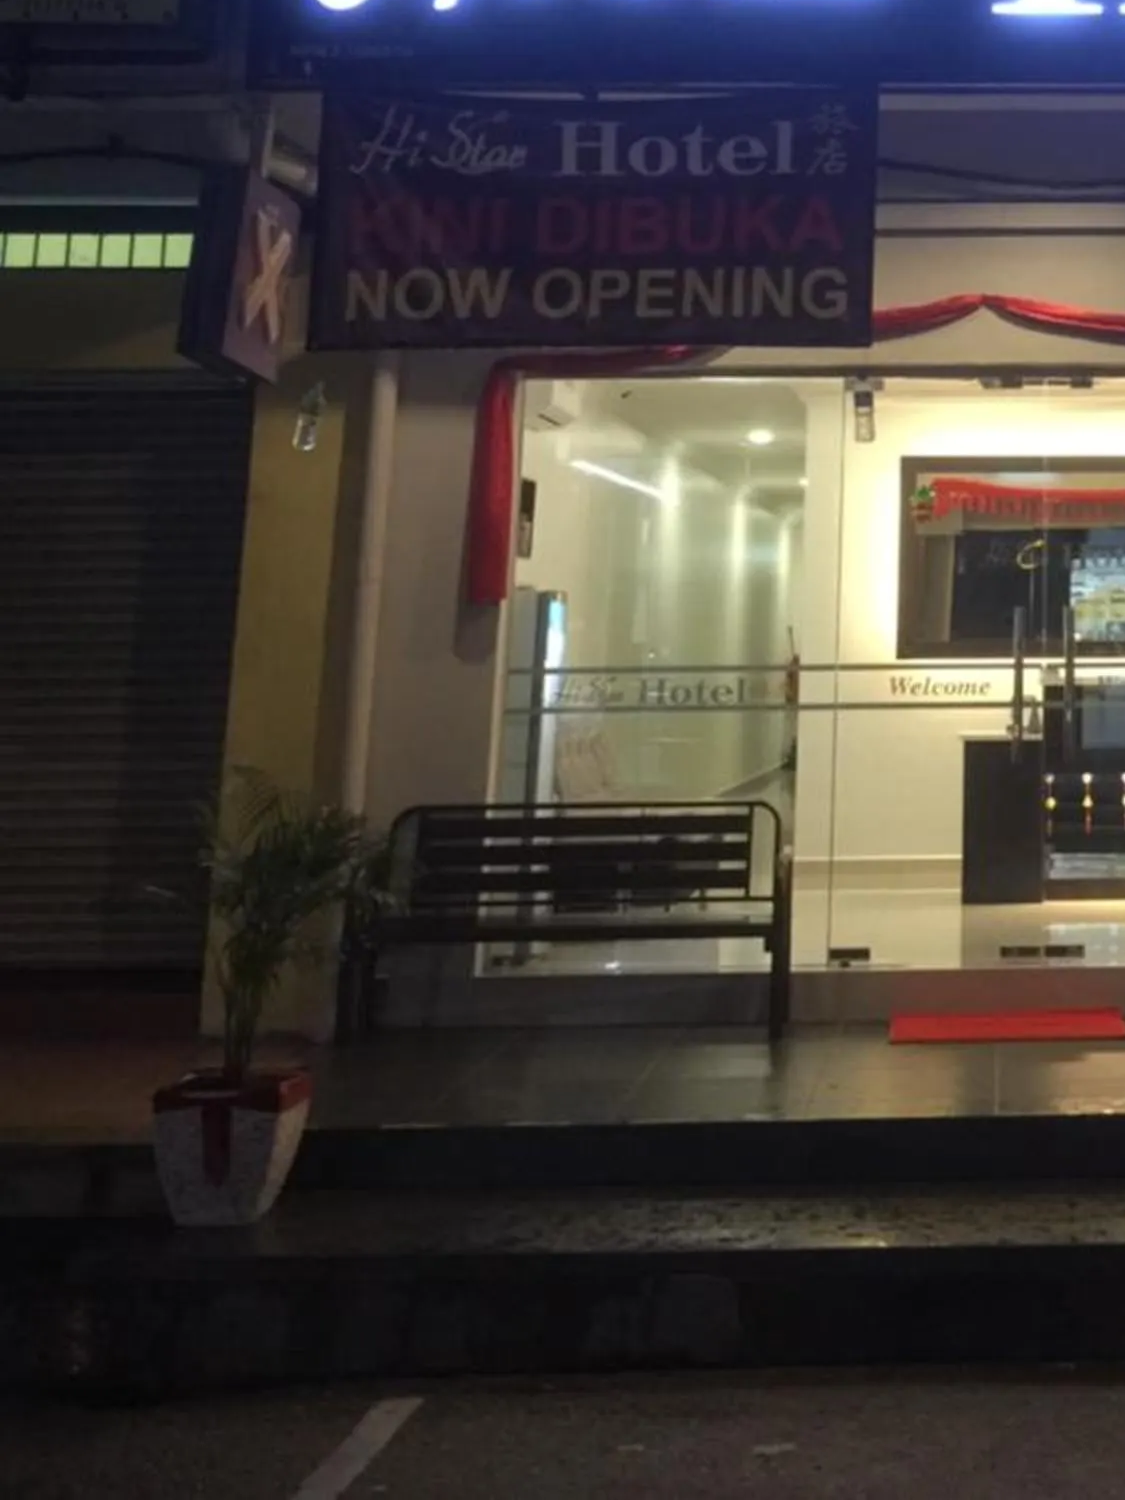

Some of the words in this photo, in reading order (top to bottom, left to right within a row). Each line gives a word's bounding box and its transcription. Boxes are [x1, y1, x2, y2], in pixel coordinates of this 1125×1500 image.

[348, 102, 429, 175] Hi
[430, 109, 528, 176] Star
[552, 119, 798, 178] Hotel
[535, 193, 845, 255] DIBUKA
[344, 266, 514, 323] NOW
[531, 265, 850, 320] OPENING
[639, 676, 745, 706] Hotel
[889, 675, 992, 697] Welcome
